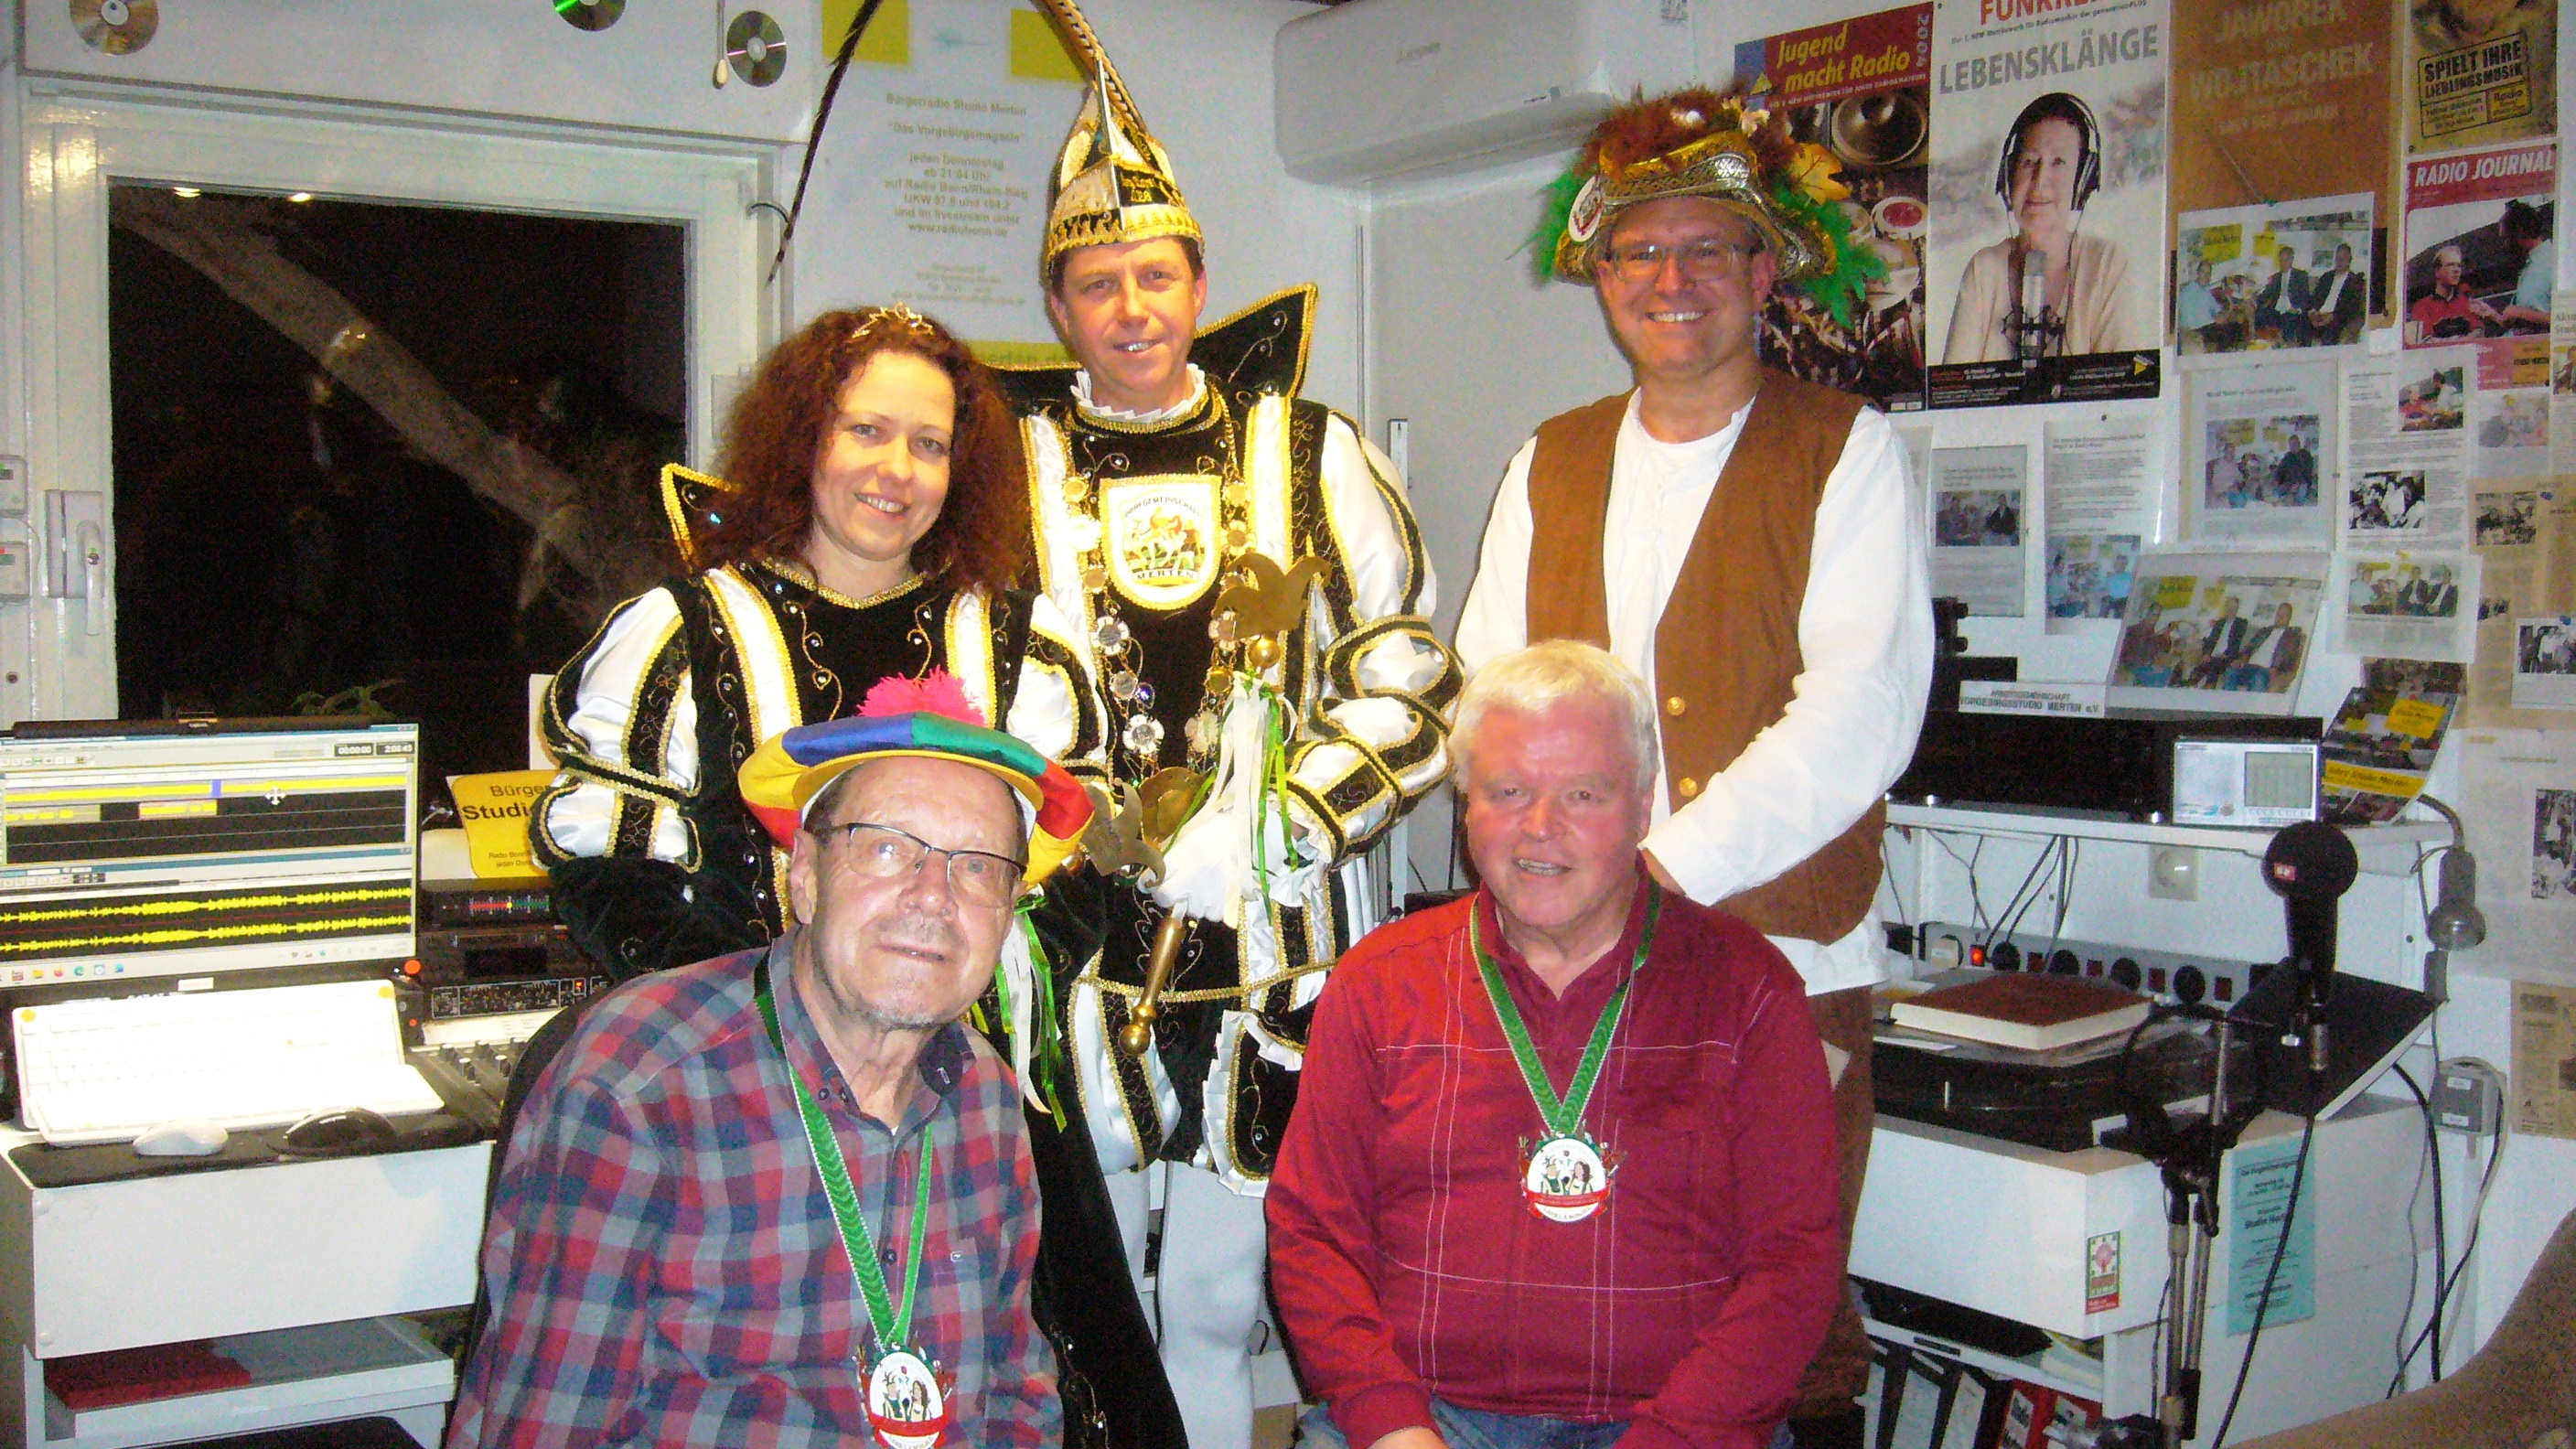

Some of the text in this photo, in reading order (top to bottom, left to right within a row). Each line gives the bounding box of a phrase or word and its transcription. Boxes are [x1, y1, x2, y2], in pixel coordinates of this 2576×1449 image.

[1776, 23, 1848, 70] Jugend
[1916, 14, 1929, 67] 2004
[1785, 46, 1910, 93] macht Radio
[1939, 25, 2158, 94] LEBENSKLÄNGE
[2424, 40, 2521, 82] SPIELT IHRE
[2425, 62, 2523, 98] LIEBLINGSMUSIK
[886, 93, 1026, 116] Bürgerradio Studio Merten
[909, 152, 1004, 171] jeden Donnerstag
[924, 167, 937, 177] ab
[2414, 149, 2554, 187] RADIO JOURNAL
[885, 178, 902, 188] auf
[906, 179, 936, 190] Radio
[904, 193, 931, 205] UKW
[959, 198, 980, 208] und
[895, 208, 915, 217] und
[918, 209, 931, 218] im
[993, 215, 1020, 224] unter
[1137, 570, 1193, 580] MERTEN
[2047, 702, 2081, 714] MERTEN
